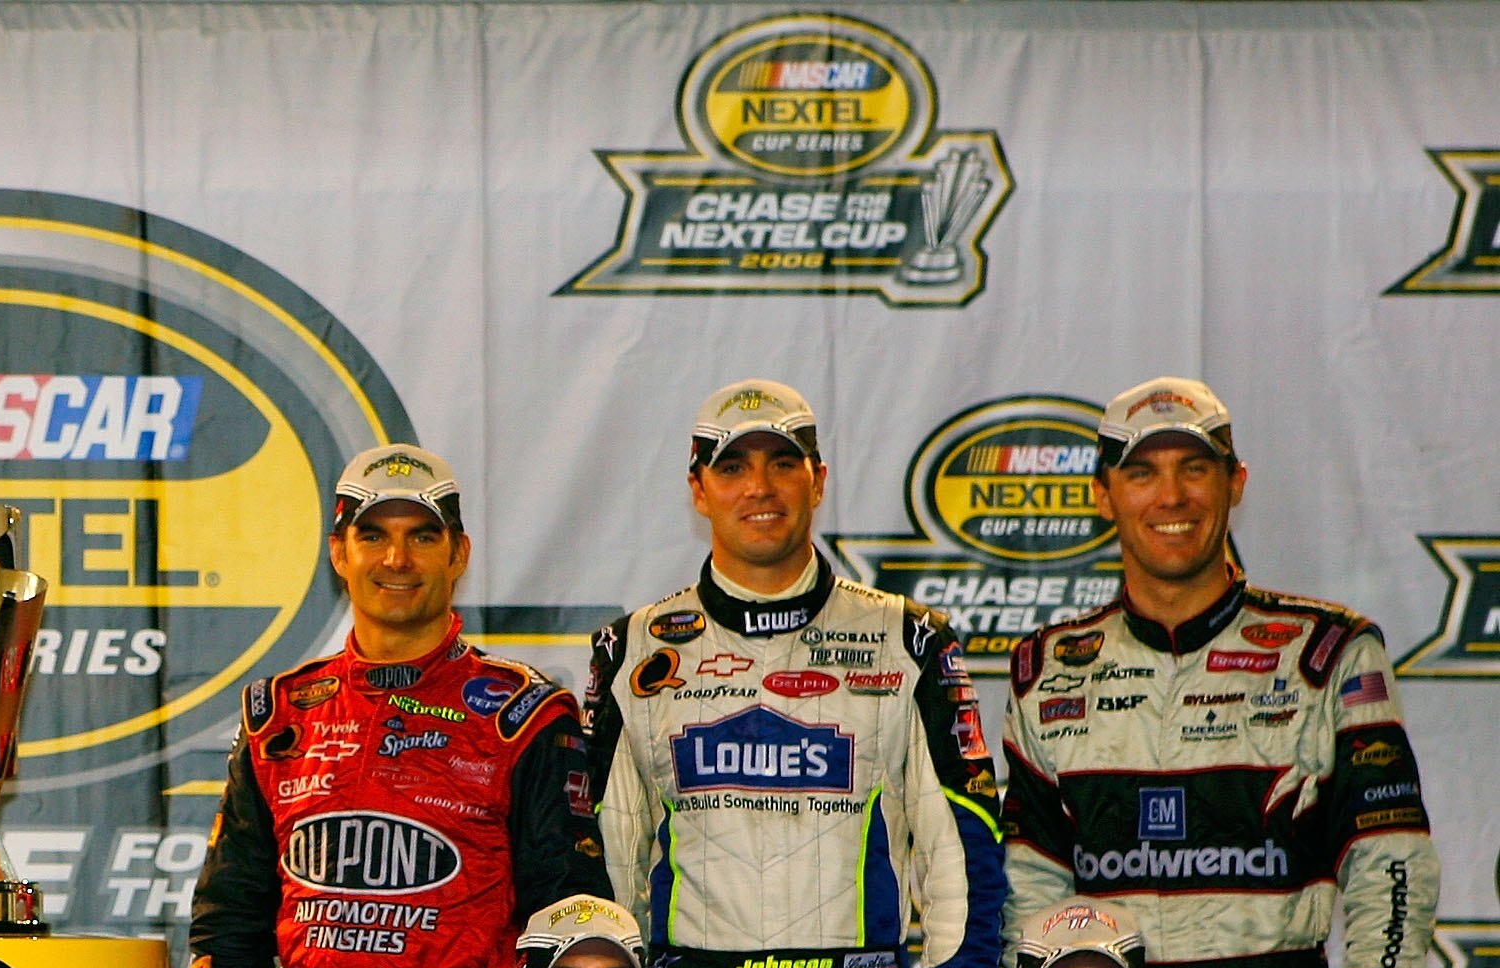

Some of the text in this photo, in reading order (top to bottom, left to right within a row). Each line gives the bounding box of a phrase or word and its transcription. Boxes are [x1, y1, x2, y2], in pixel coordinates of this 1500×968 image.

[778, 62, 869, 89] NASCAR
[742, 98, 874, 125] NEXTEL
[751, 134, 863, 152] CUP SERIES
[685, 193, 836, 222] CHASE
[659, 223, 907, 249] NEXTEL CUP
[739, 253, 825, 270] 2006
[386, 463, 412, 478] 24
[1008, 445, 1097, 473] NASCAR
[980, 518, 1093, 537] CUP SERIES
[913, 577, 1069, 606] CHASE
[744, 608, 809, 633] LOWE'S
[947, 607, 1046, 633] XTEL
[825, 632, 887, 644] KOBALT
[32, 628, 167, 677] RIES
[771, 679, 830, 689] DELPHI
[843, 671, 904, 687] Hendrick
[674, 685, 758, 701] GOODYEAR
[1182, 692, 1246, 707] SYLVANIA
[312, 720, 361, 737] Tyvek
[1182, 724, 1238, 736] EMERSON
[378, 731, 448, 757] Sparkle
[694, 736, 829, 778] LOWE'S
[277, 773, 335, 797] GMAC
[414, 795, 489, 816] GOODYEAR
[691, 794, 866, 816] Build Something Together
[1149, 797, 1177, 823] GM
[111, 832, 201, 873] FO
[105, 877, 195, 918] TH
[293, 899, 440, 930] AUTOMOTIVE
[304, 926, 406, 954] FINISHES
